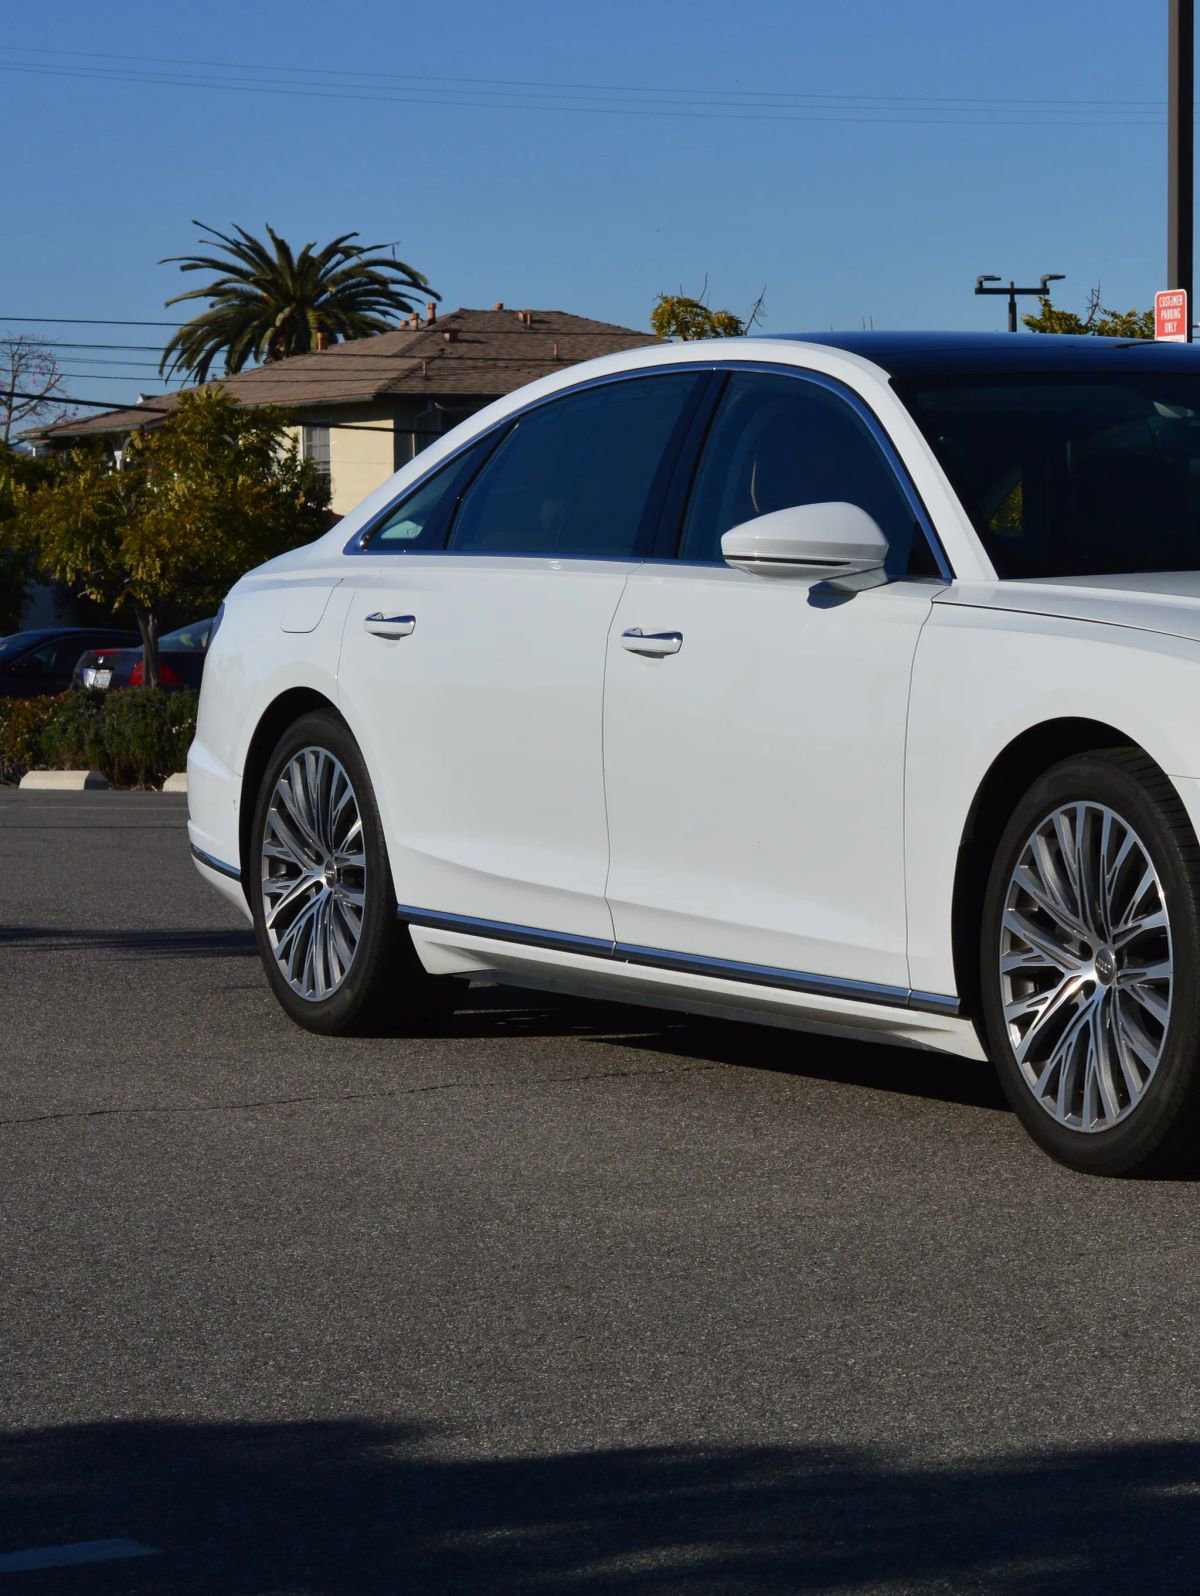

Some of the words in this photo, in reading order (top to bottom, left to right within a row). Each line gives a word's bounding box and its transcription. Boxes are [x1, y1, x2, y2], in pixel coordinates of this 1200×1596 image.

[1159, 295, 1183, 307] CUSTOMER
[1161, 308, 1181, 320] PARKING
[1164, 321, 1177, 333] ONLY
